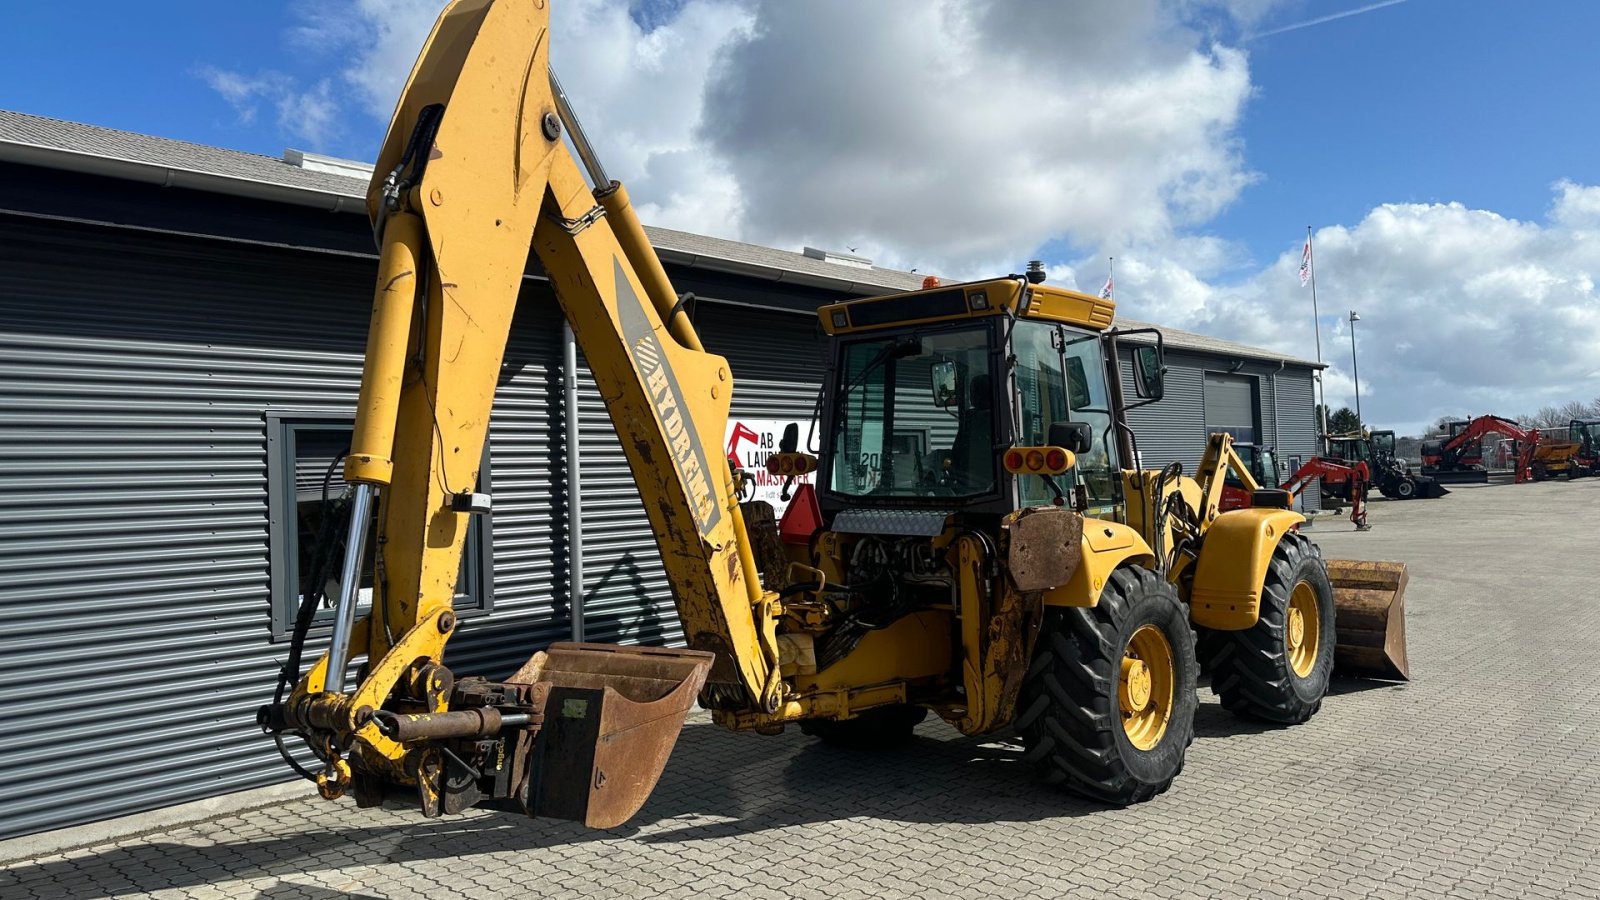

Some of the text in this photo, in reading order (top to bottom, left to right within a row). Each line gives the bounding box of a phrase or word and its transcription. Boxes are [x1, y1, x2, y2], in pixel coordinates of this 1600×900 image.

[647, 363, 715, 527] HYDREMA
[760, 432, 774, 449] AB
[756, 470, 809, 487] MASKNER
